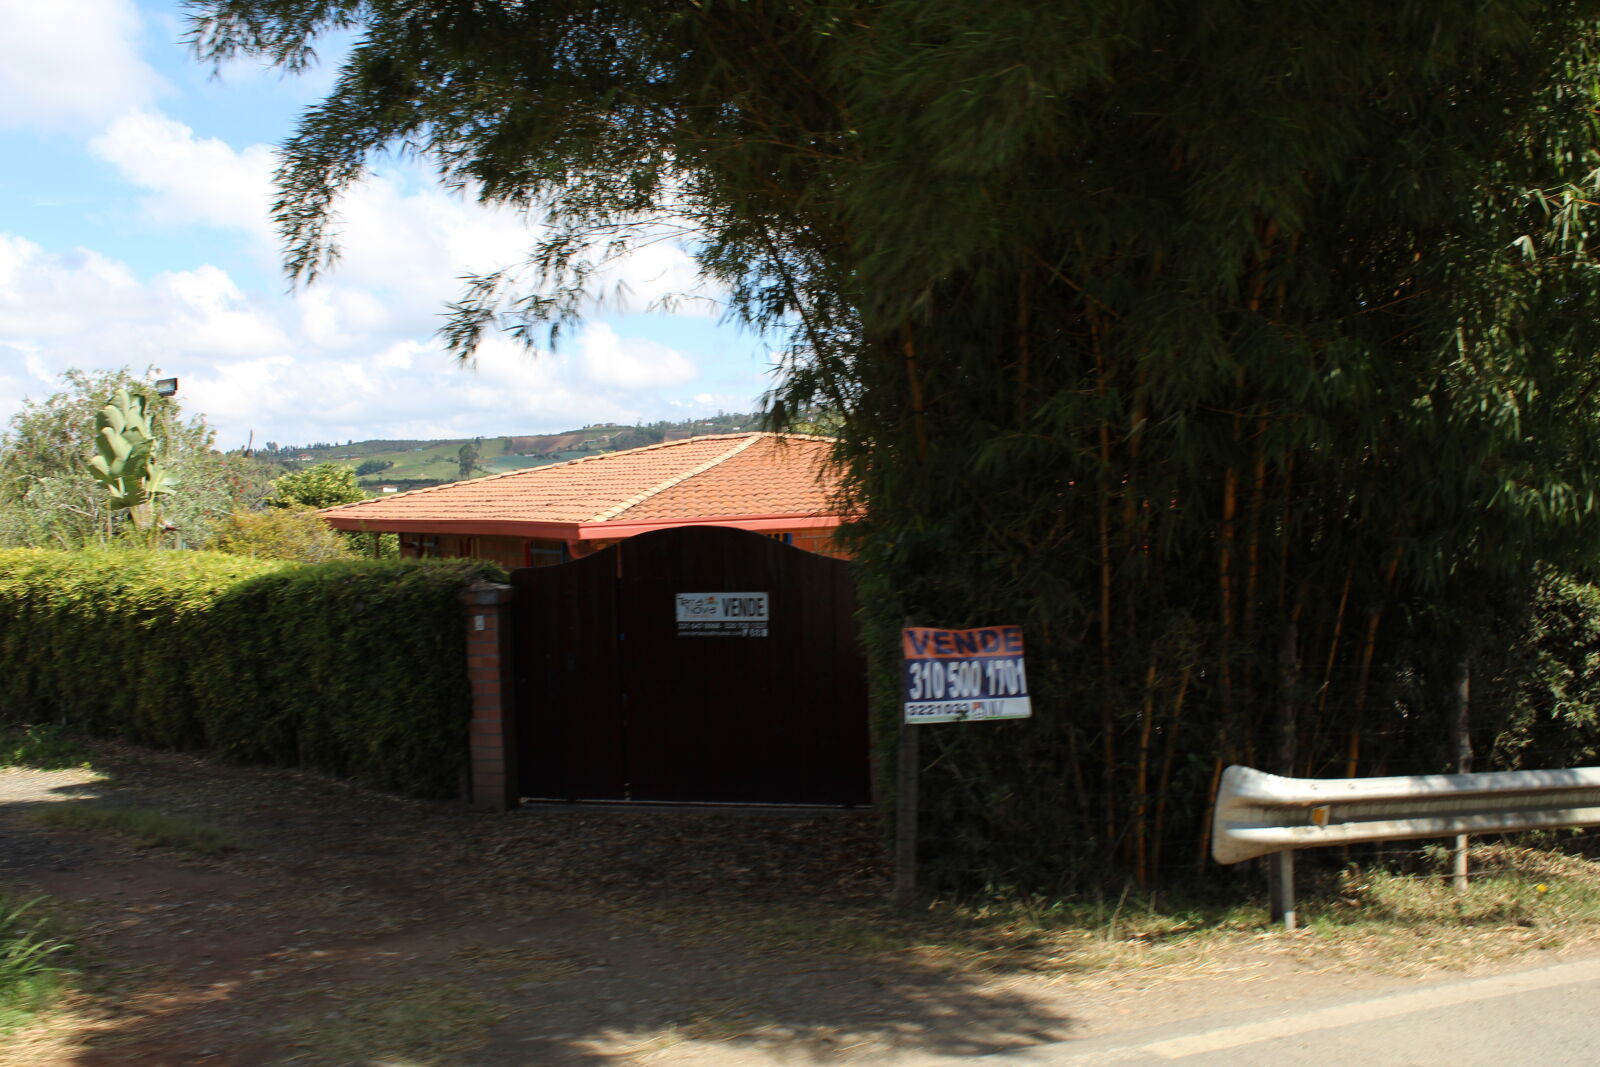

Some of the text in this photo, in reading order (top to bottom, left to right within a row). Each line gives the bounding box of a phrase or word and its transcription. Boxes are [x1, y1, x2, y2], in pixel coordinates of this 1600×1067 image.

[723, 598, 765, 617] VENDE
[908, 629, 1024, 655] VENDE
[909, 658, 1028, 700] 310 500 1701
